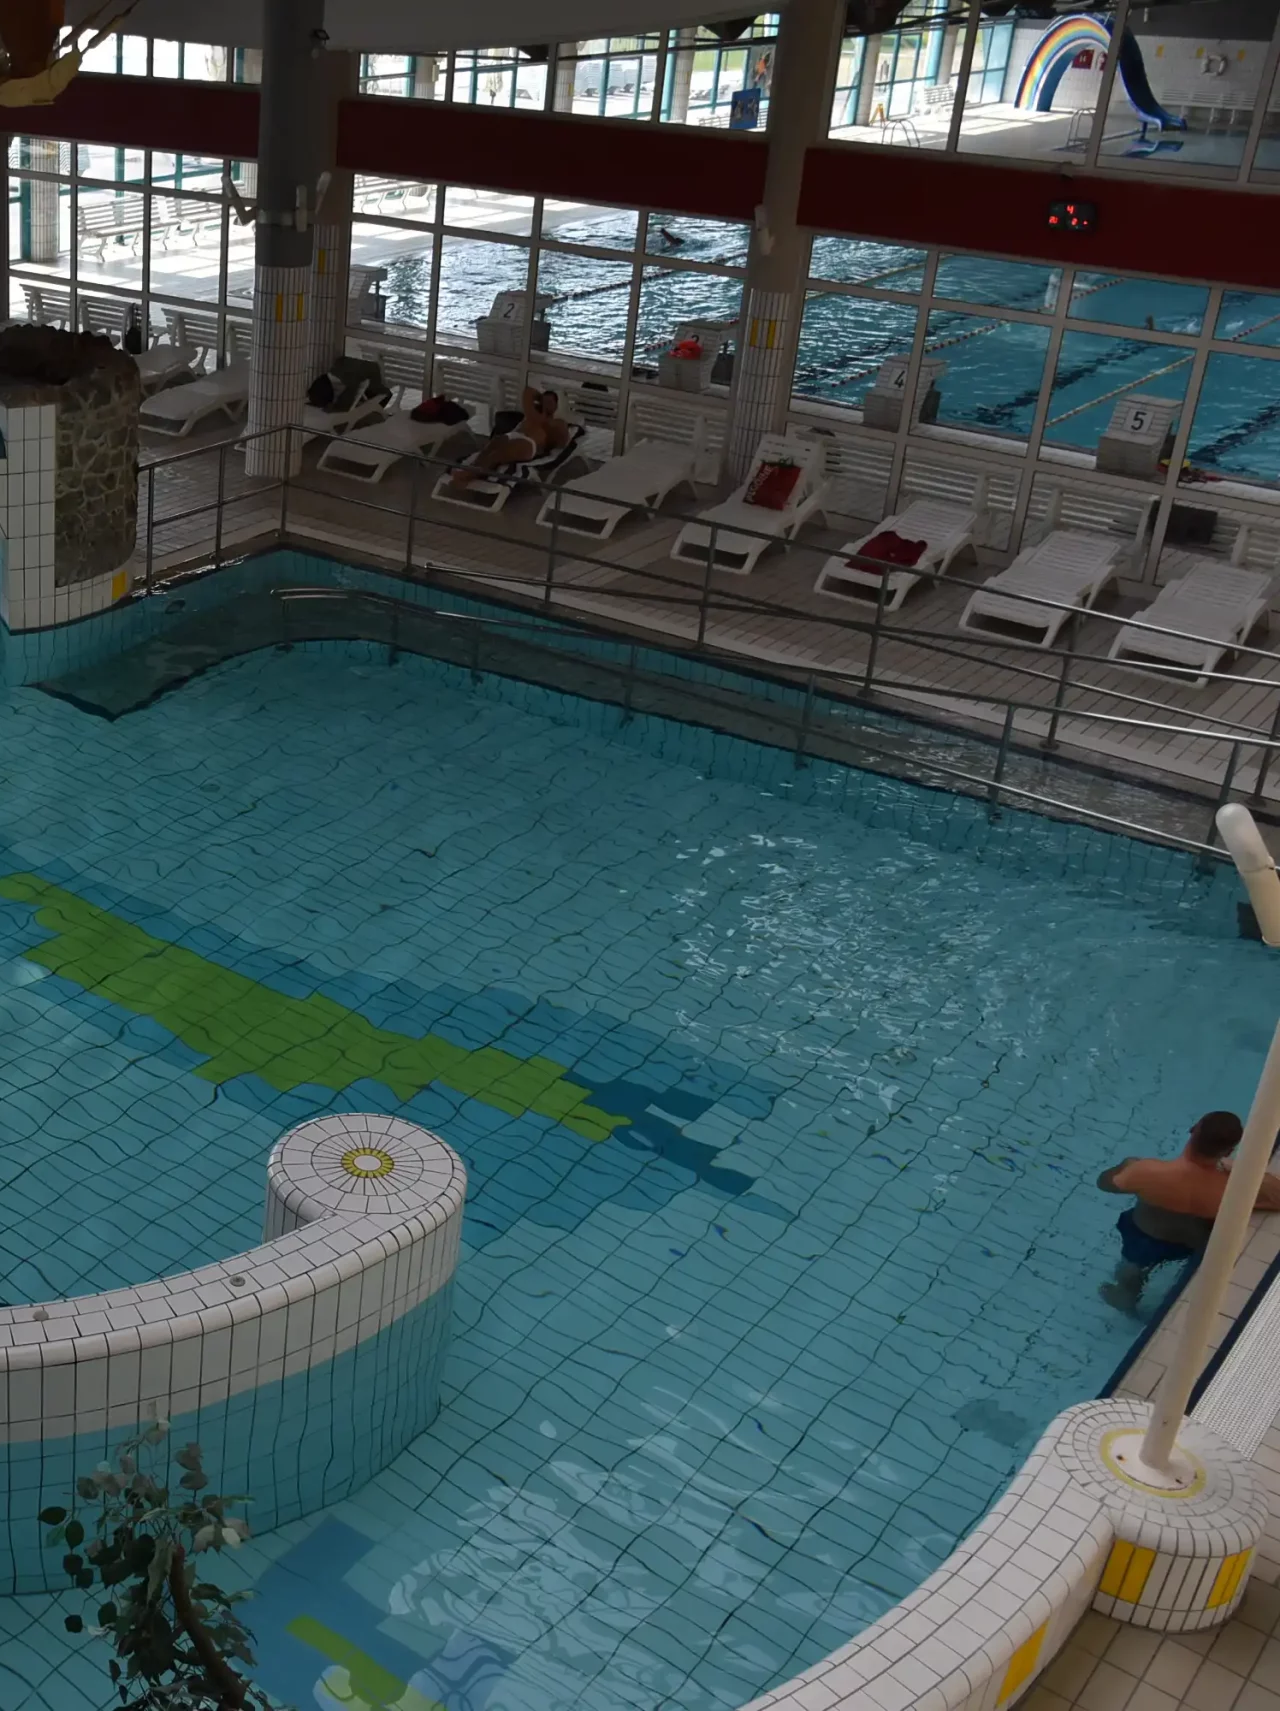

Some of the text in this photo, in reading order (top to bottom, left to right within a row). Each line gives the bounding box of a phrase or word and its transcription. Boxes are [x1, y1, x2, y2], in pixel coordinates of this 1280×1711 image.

[503, 302, 515, 319] 2
[894, 370, 906, 388] 4
[1130, 411, 1147, 431] 5
